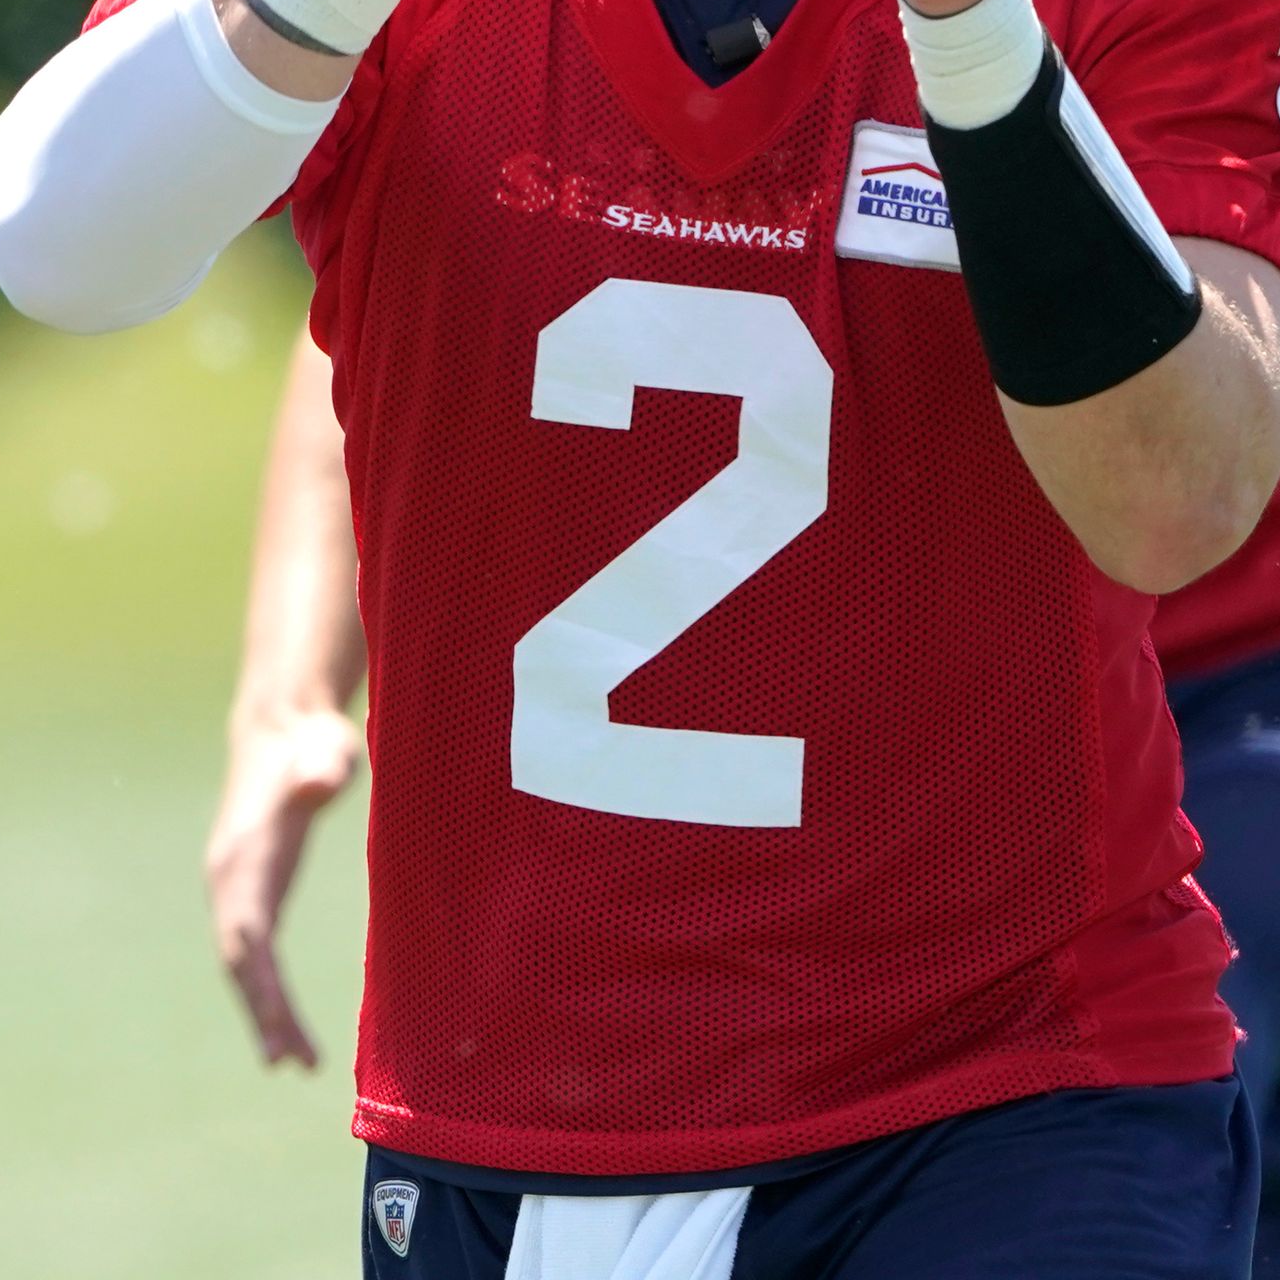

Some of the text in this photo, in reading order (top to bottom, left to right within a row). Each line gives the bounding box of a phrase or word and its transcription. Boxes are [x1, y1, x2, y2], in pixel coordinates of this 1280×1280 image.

[860, 178, 949, 208] AMERICA
[871, 201, 954, 228] INSUR
[511, 278, 833, 827] 2
[377, 1187, 415, 1202] EQUIPMENT
[387, 1221, 404, 1240] NFL
